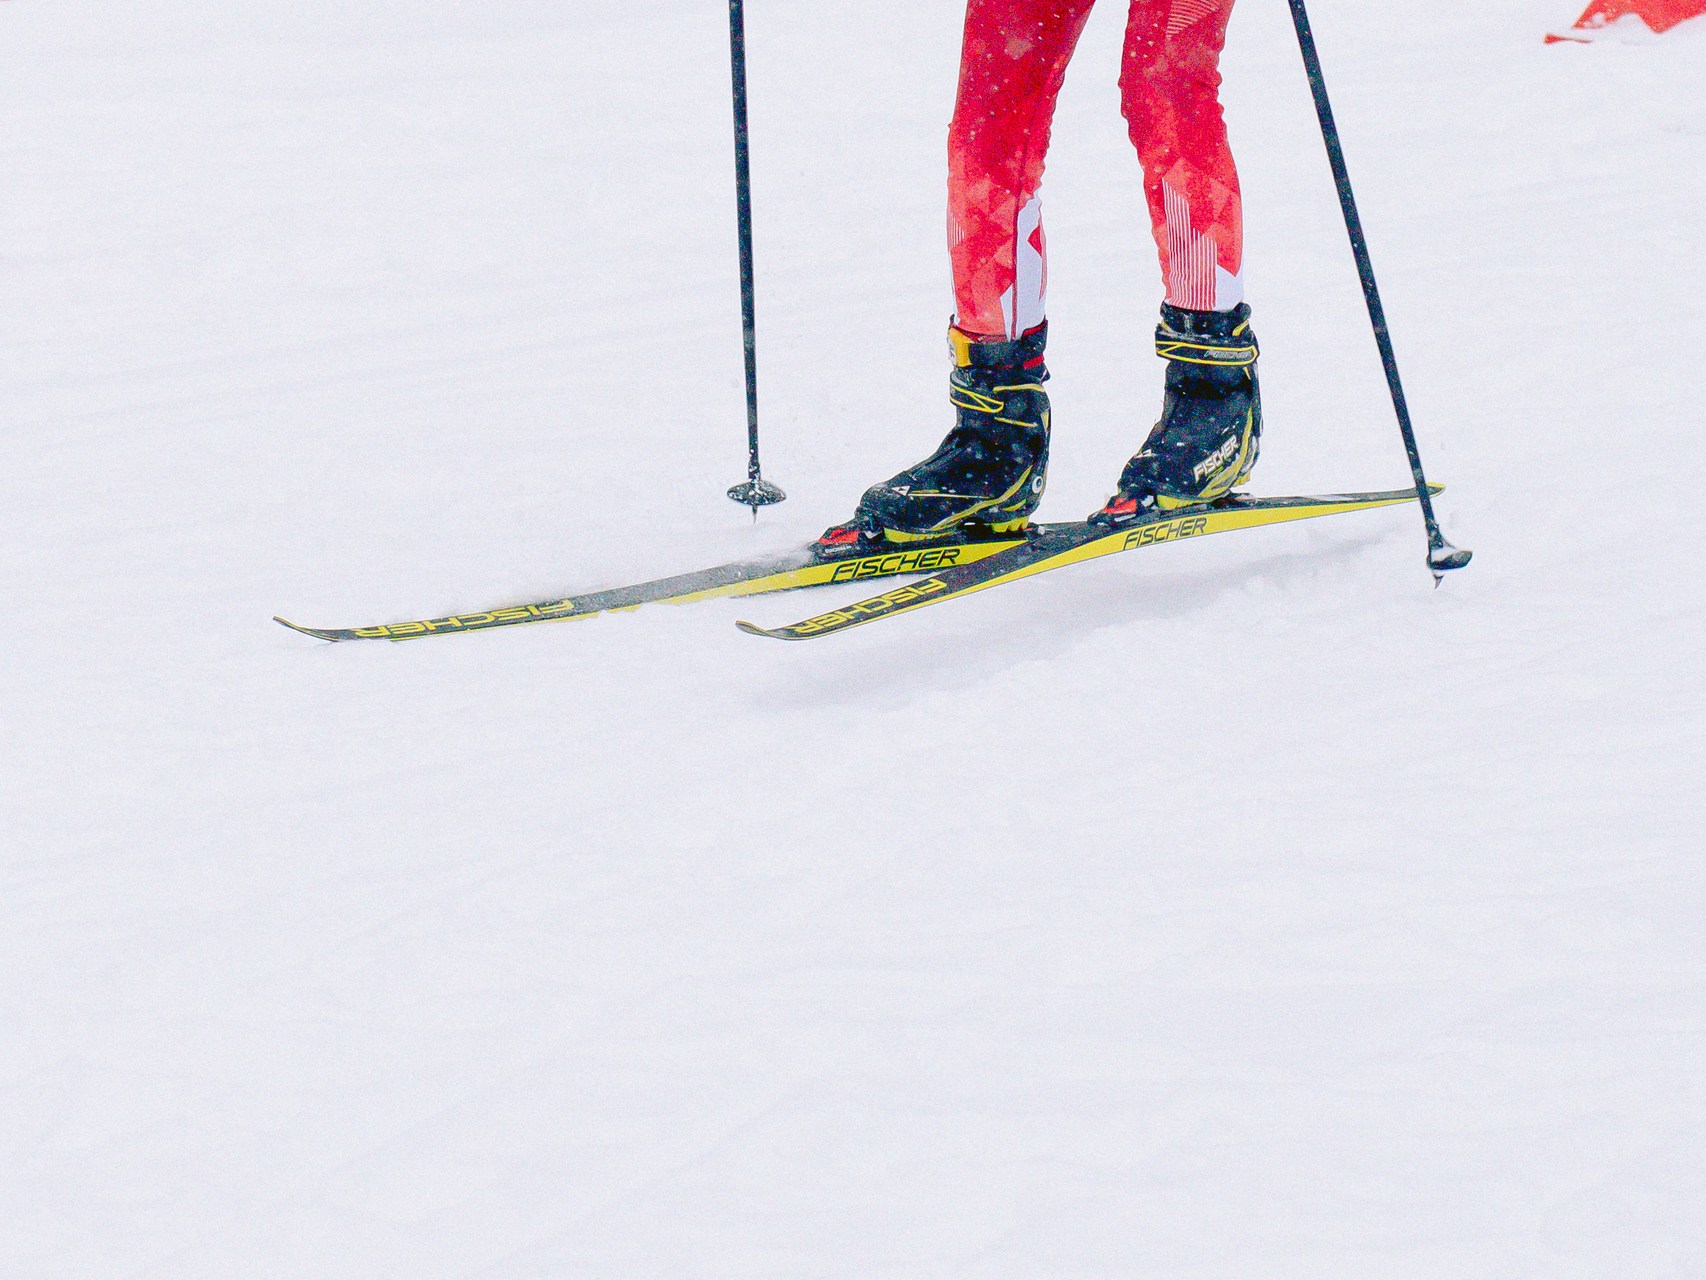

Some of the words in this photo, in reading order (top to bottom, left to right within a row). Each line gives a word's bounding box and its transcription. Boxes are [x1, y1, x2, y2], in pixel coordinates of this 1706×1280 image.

[1193, 434, 1240, 484] FISCHER
[1123, 517, 1207, 551] FISCHER
[830, 548, 961, 583] FISCHER
[353, 599, 574, 638] FISCHER
[787, 579, 948, 634] FISCHER
